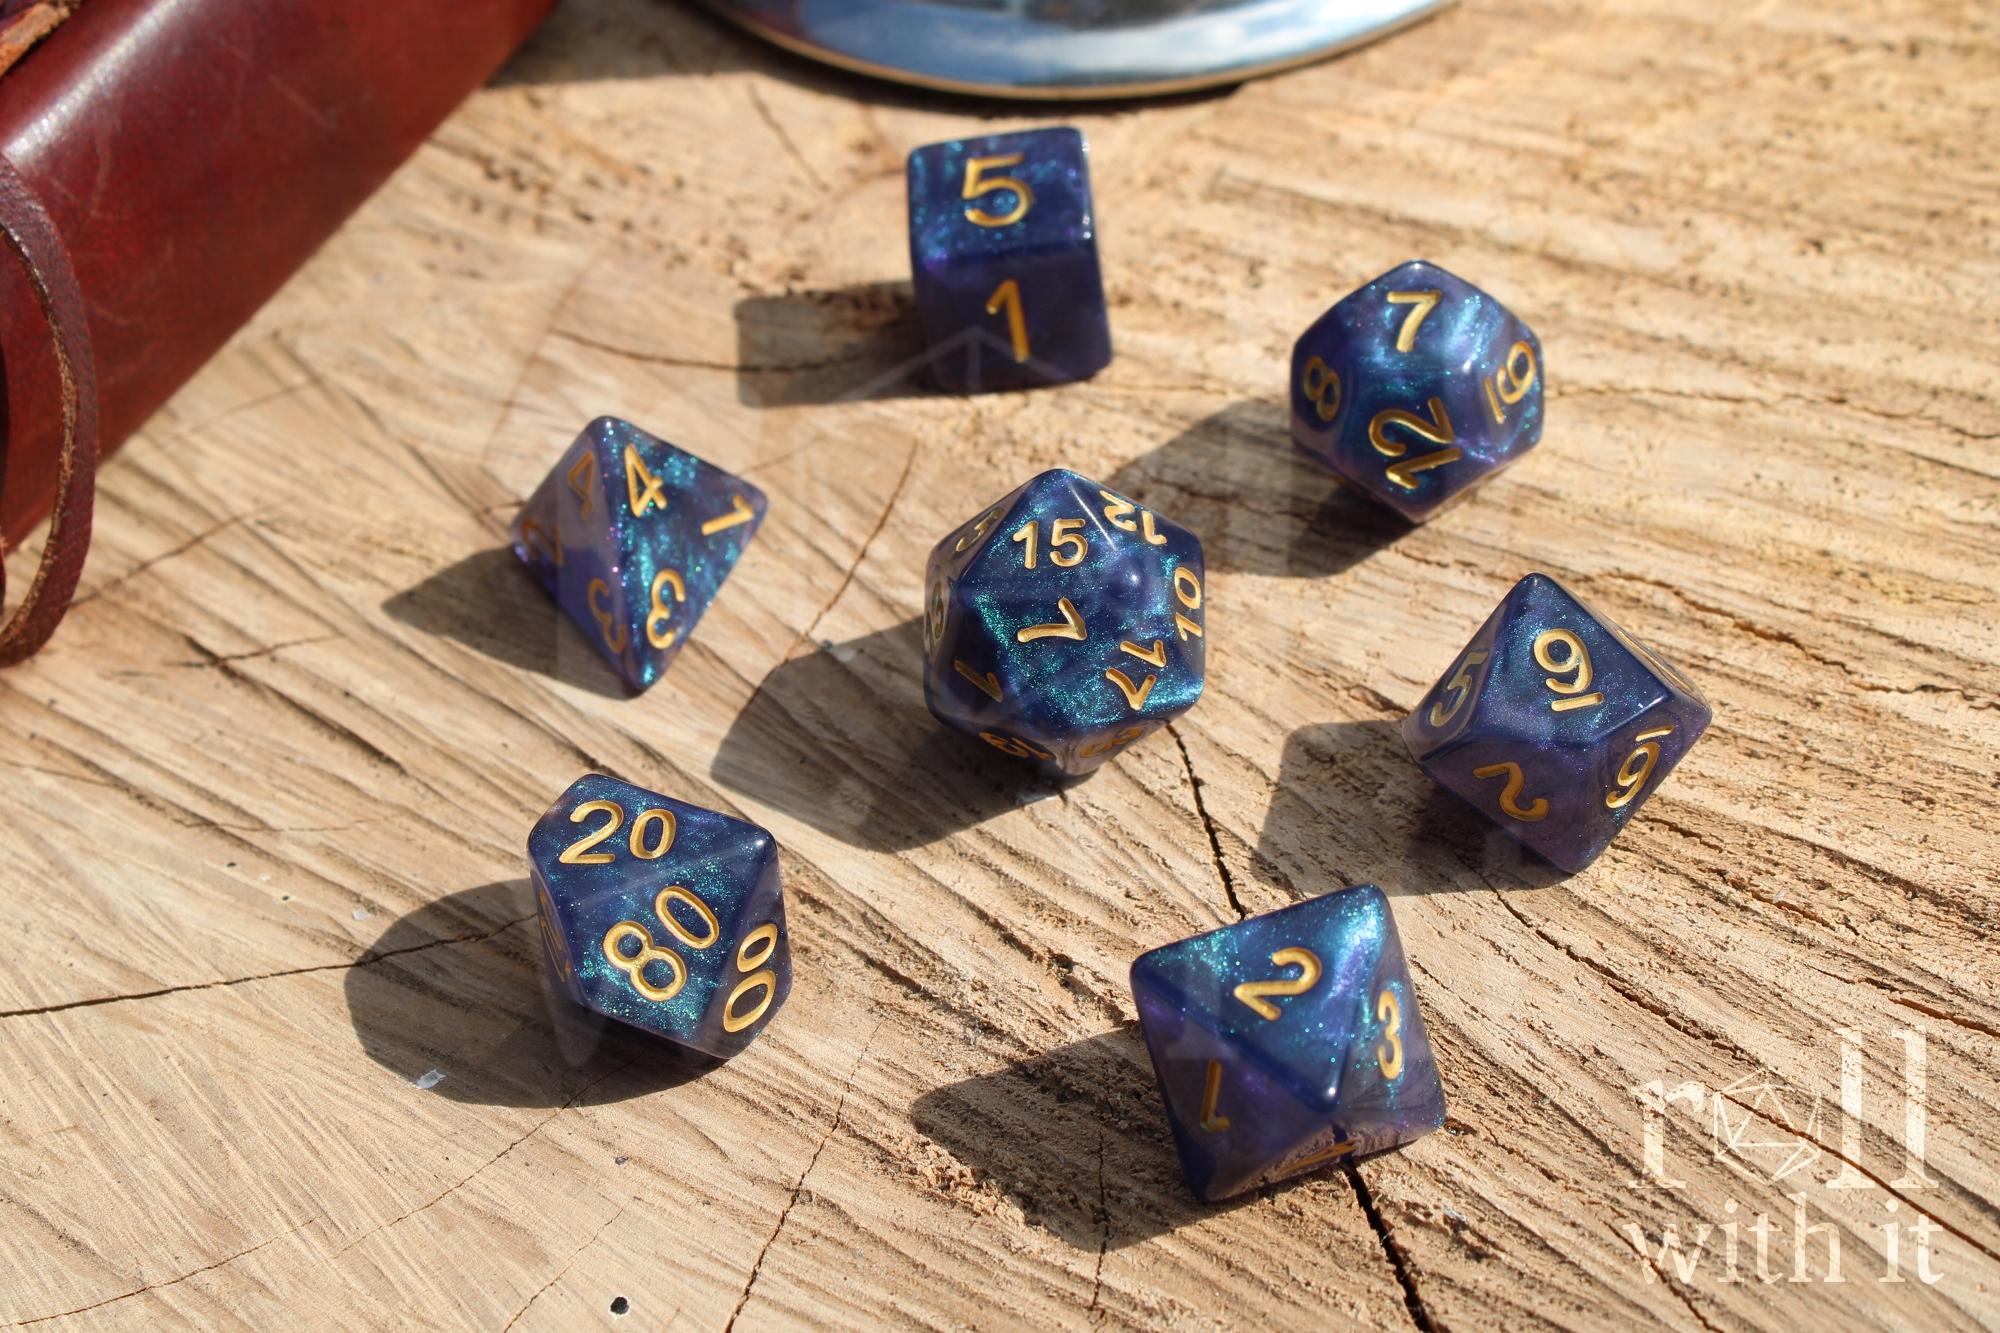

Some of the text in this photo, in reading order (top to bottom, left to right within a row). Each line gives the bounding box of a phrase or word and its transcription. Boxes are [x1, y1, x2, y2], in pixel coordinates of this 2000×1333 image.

[962, 153, 1034, 227] 5
[986, 279, 1030, 363] 1
[1387, 290, 1441, 353] 7
[1303, 356, 1341, 422] 8
[624, 443, 667, 517] 4
[1368, 397, 1462, 489] 12
[568, 452, 595, 520] 4
[702, 495, 755, 535] 1
[1013, 519, 1088, 569] 15
[588, 578, 627, 653] 3
[647, 568, 686, 649] 3
[1174, 566, 1203, 641] 10
[1106, 640, 1166, 710] 17
[1430, 651, 1489, 728] 5
[1533, 628, 1604, 712] 9
[1472, 761, 1549, 822] 2
[559, 800, 676, 864] 20
[603, 885, 720, 1002] 80
[723, 923, 778, 1033] 00
[1234, 947, 1322, 1021] 2
[1378, 990, 1403, 1080] 3
[1200, 1057, 1230, 1132] 1
